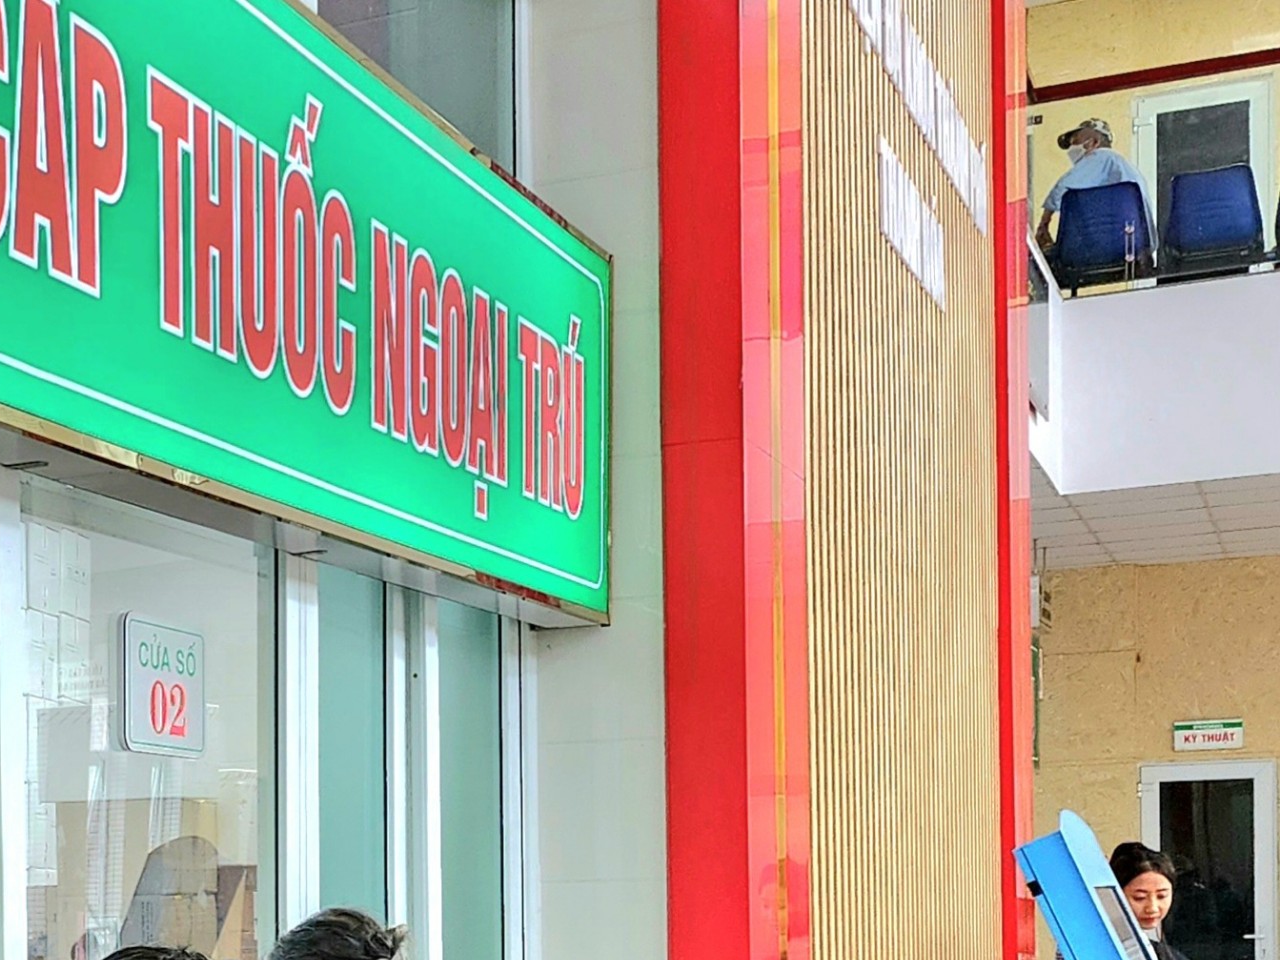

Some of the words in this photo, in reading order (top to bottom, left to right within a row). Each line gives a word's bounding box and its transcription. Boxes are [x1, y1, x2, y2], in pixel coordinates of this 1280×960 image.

[146, 64, 357, 416] THUỐC
[370, 217, 508, 520] NGOẠI
[517, 314, 585, 520] TRÚ
[138, 633, 171, 673] CỬA
[149, 680, 186, 738] 02
